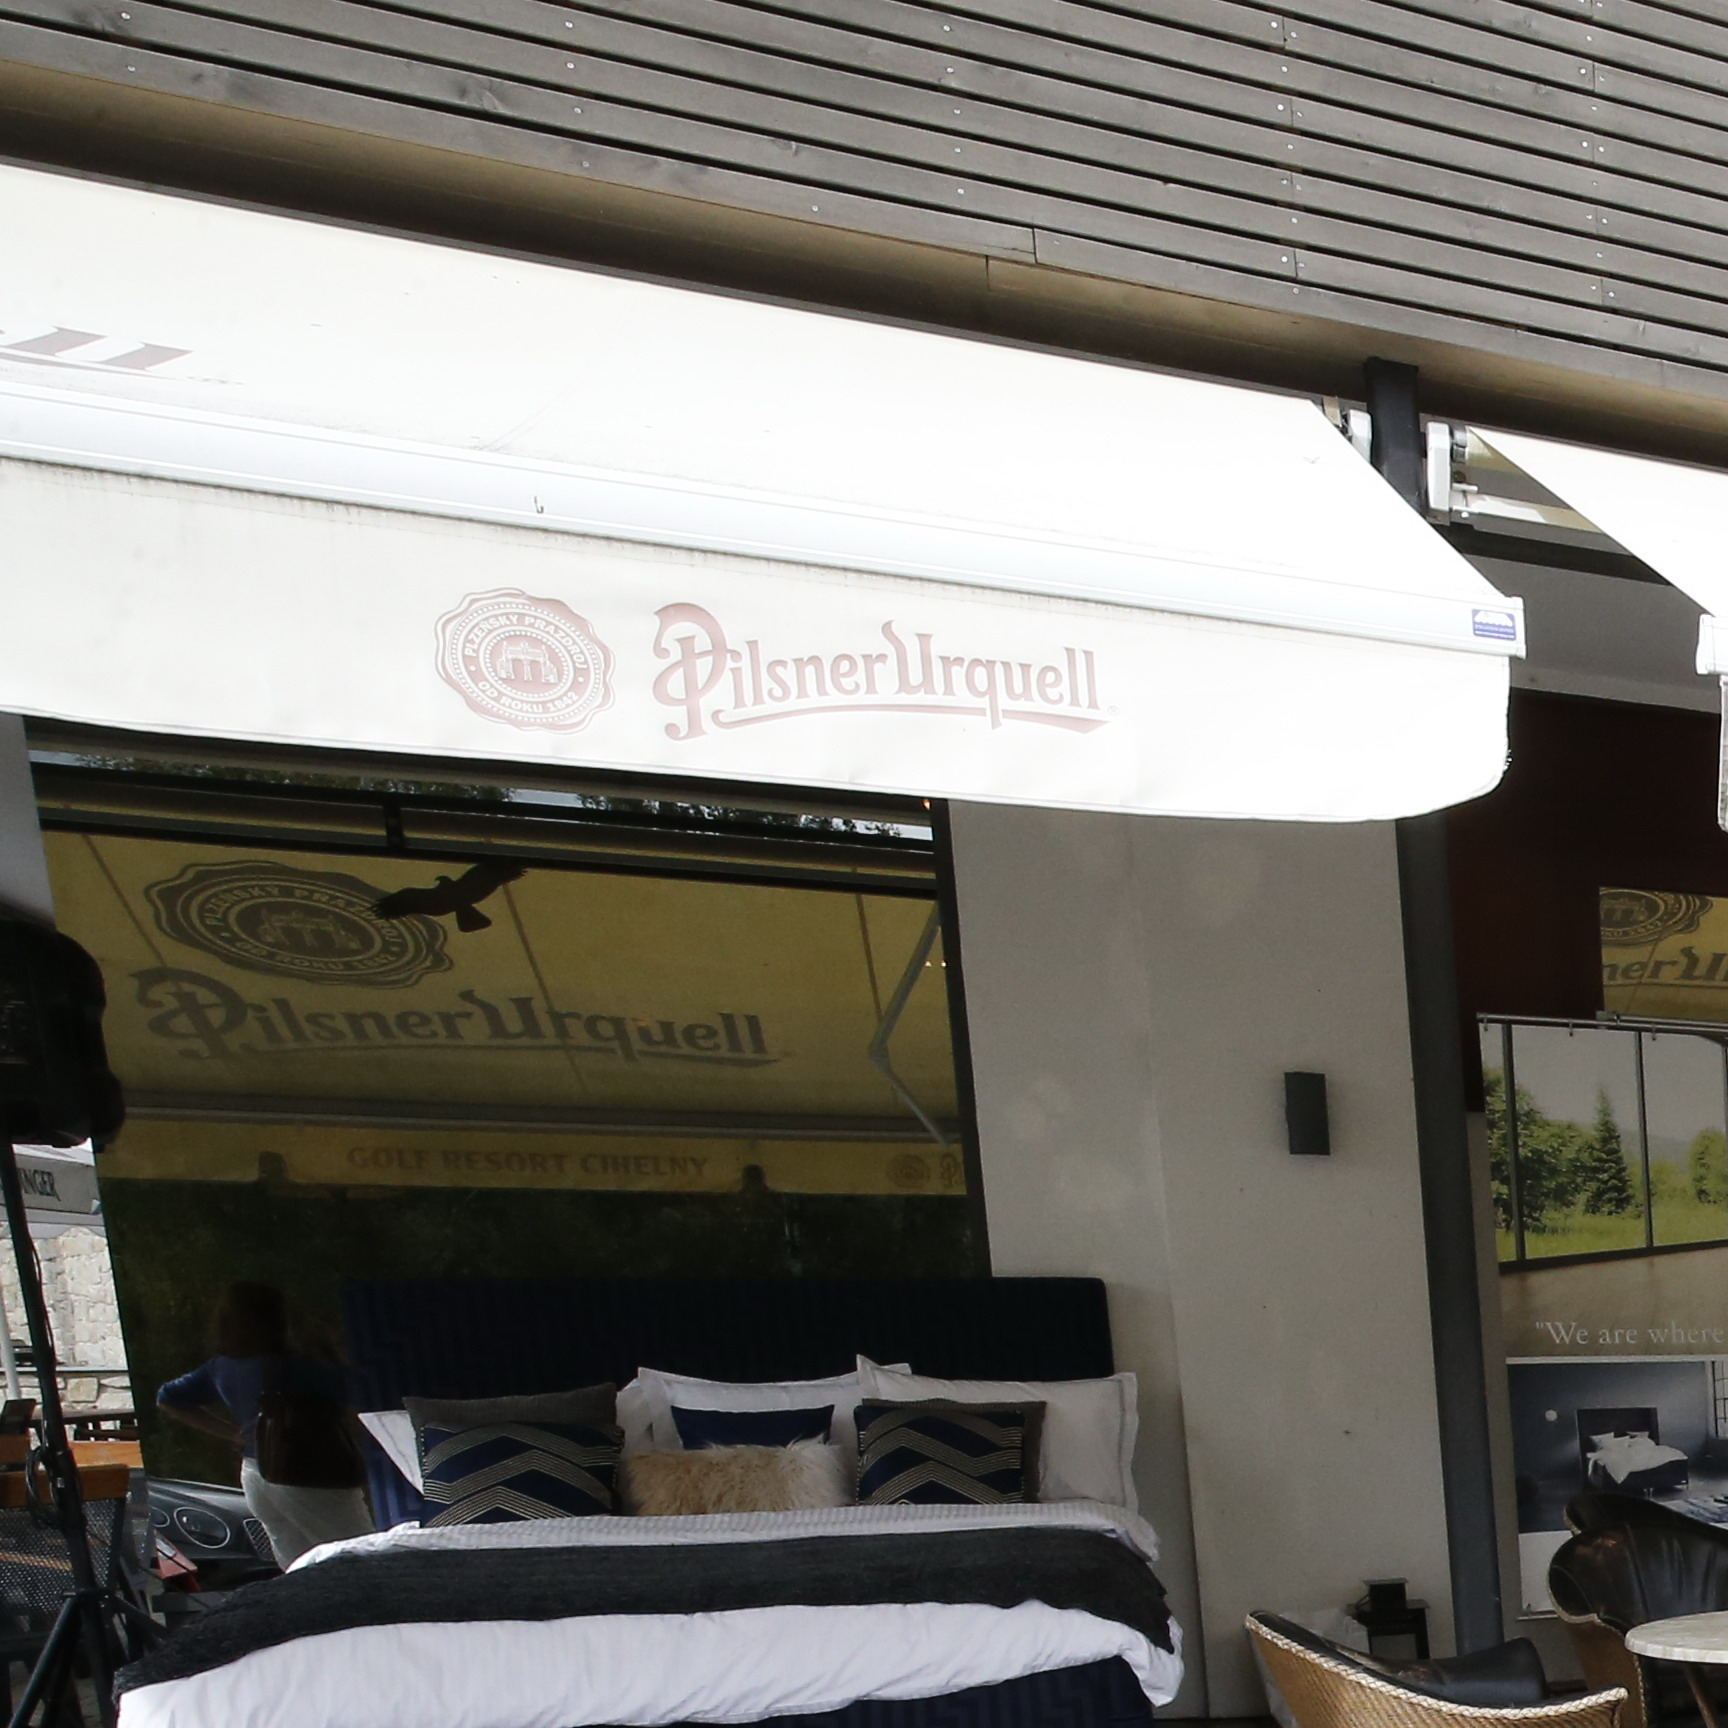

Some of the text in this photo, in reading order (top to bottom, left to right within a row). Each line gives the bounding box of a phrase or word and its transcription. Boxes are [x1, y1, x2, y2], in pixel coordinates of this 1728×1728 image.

[525, 615, 588, 669] PRAZDROJ
[652, 602, 1101, 741] Pilsner Urquell
[128, 967, 771, 1066] Pilsner Urquell
[346, 1147, 709, 1177] GOLF RESORT CIHELNY
[1599, 1328, 1638, 1344] are
[1647, 1320, 1724, 1343] where
